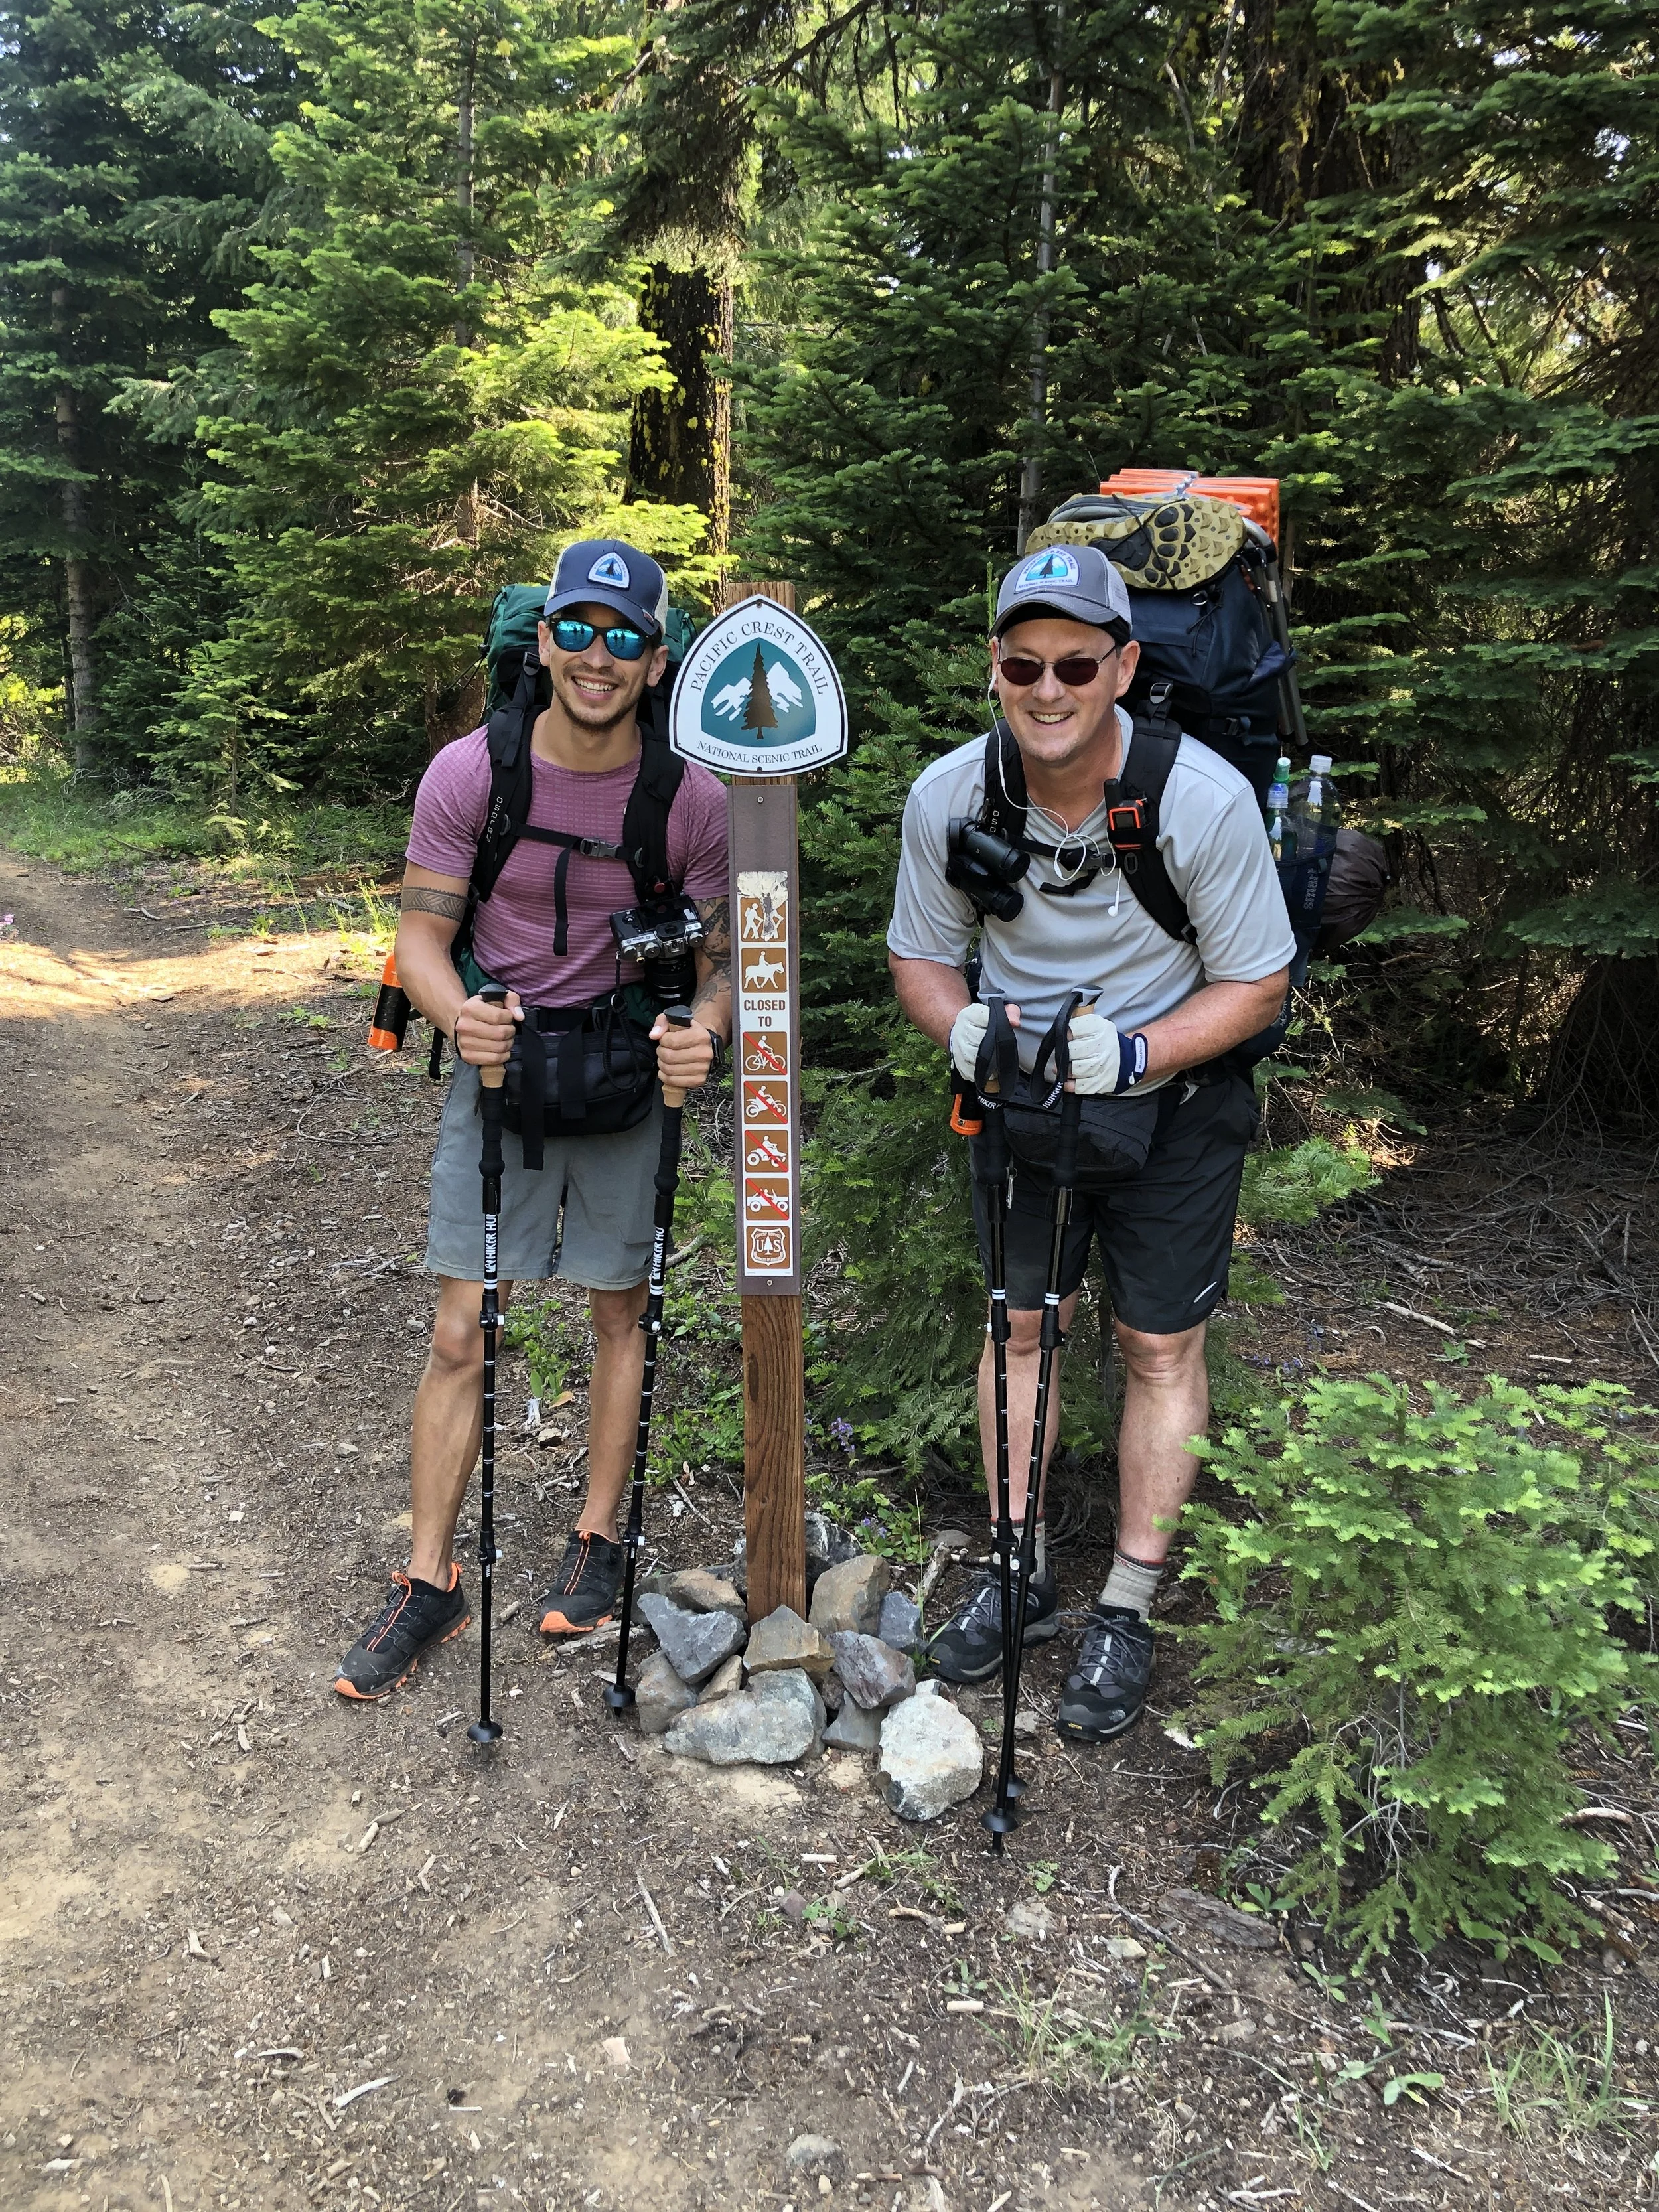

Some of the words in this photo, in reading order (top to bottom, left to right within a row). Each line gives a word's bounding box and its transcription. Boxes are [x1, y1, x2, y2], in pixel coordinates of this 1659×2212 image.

[690, 631, 738, 692] PACIFIC
[741, 621, 795, 645] CREST
[794, 642, 829, 694] TRAIL
[697, 740, 749, 763] NATIONAL
[751, 752, 790, 764] SCENIC
[791, 744, 822, 760] TRAIL
[744, 999, 786, 1011] CLOSED
[758, 1016, 772, 1027] TO
[1042, 1082, 1064, 1108] HUNGER
[485, 1232, 496, 1259] HIKER
[652, 1242, 664, 1268] HIKER
